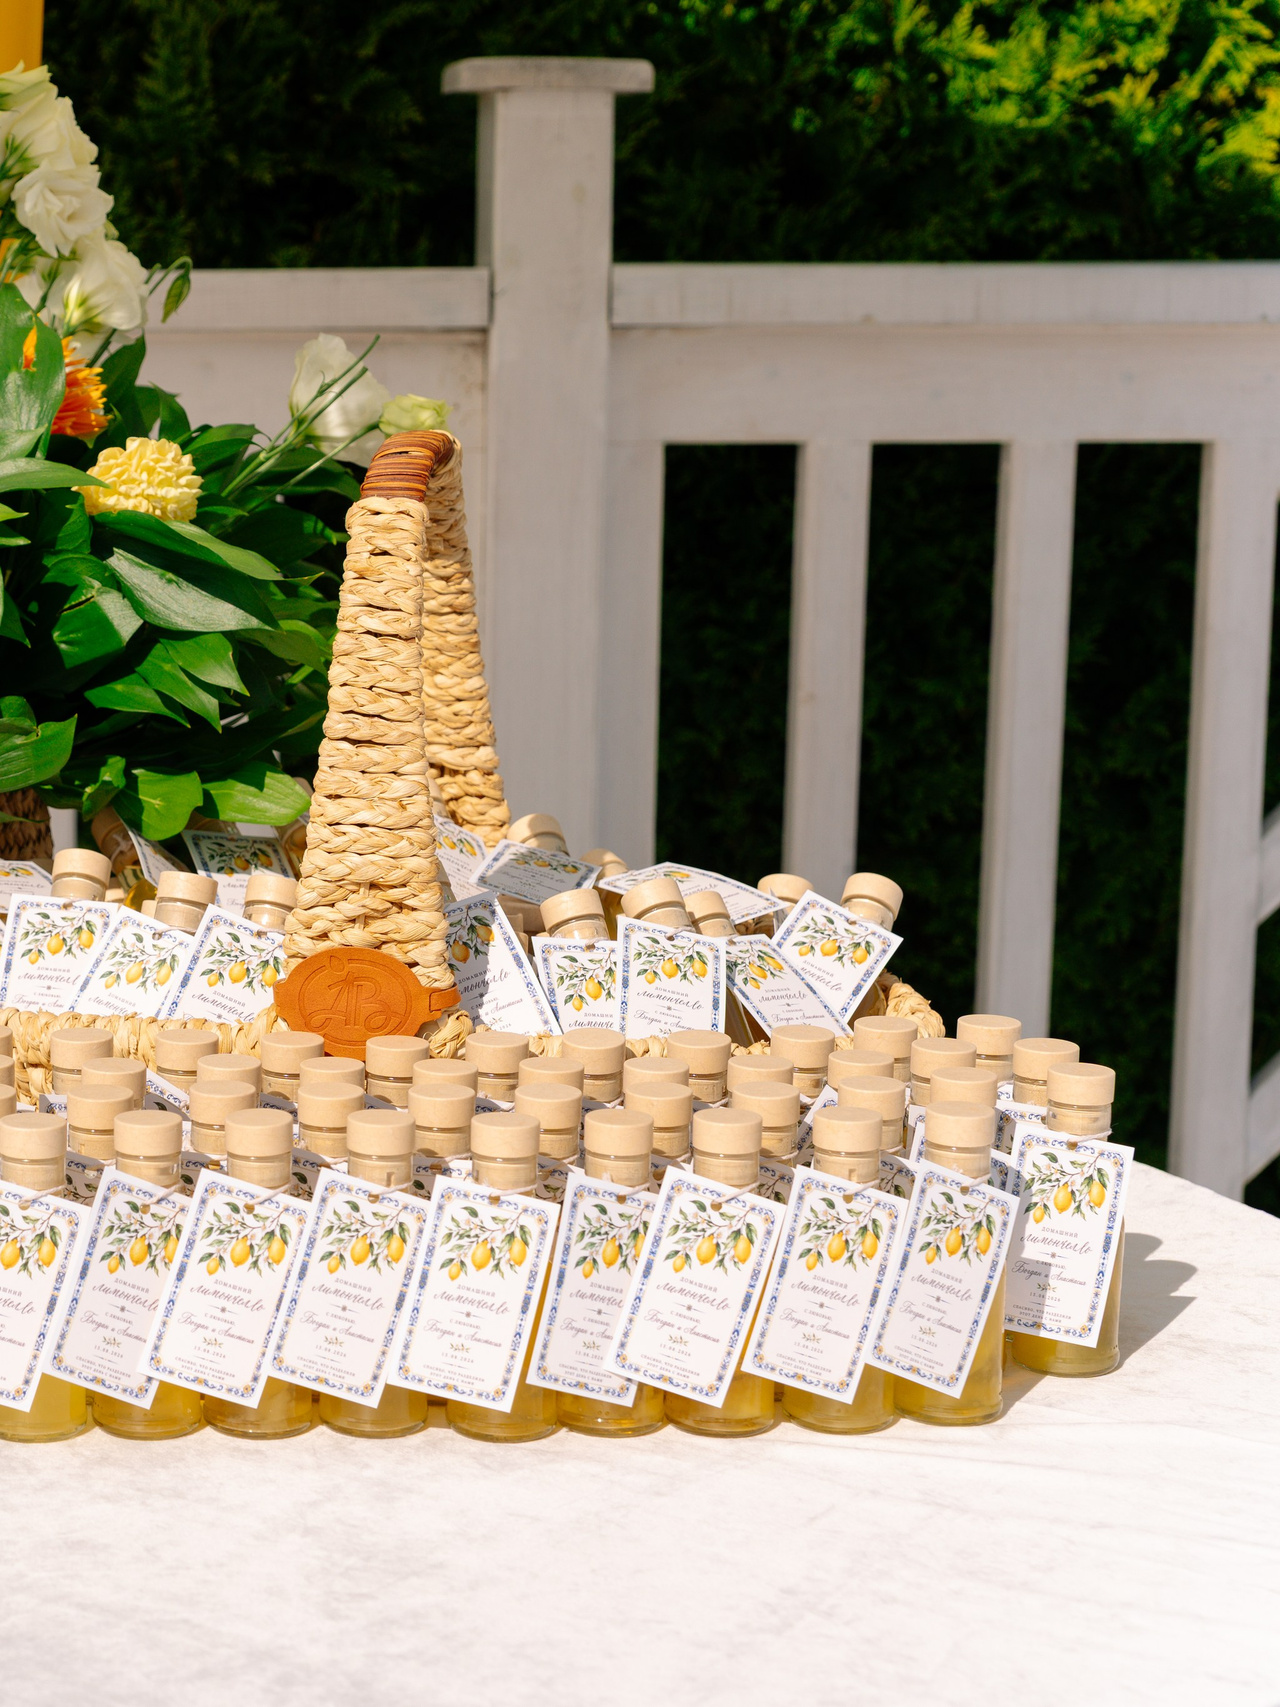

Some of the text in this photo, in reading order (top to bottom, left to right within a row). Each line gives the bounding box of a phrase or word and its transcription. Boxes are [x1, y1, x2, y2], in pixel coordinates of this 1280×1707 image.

[458, 969, 491, 984] ДОМАШНИЙ
[213, 990, 246, 1007] ДОМАШНИЙ
[655, 986, 689, 997] ДОМАШНИЙ
[569, 1018, 614, 1028] лимонче
[634, 1010, 661, 1026] Богдан
[1041, 1226, 1078, 1238] ДОМАШНИЙ
[812, 1274, 847, 1289] ДОМАШНИЙ
[930, 1268, 961, 1284] ДОМАШНИЙ
[1012, 1260, 1042, 1283] Богдан
[1050, 1270, 1086, 1286] Анастасия
[114, 1277, 149, 1294] ДОМАШНИЙ
[213, 1278, 252, 1294] ДОМАШНИЙ
[334, 1277, 372, 1293] ДОМАШНИЙ
[456, 1284, 496, 1298] ДОМАШНИЙ
[589, 1281, 622, 1294] ДОМАШНИЙ
[680, 1276, 718, 1293] ДОМАШНИЙ
[779, 1307, 808, 1333] Богдан
[816, 1322, 850, 1339] Анастасия
[899, 1300, 925, 1326] Богдан
[931, 1316, 962, 1334] Анастасия
[80, 1310, 109, 1337] Богдан
[116, 1326, 147, 1344] Анастаси
[177, 1311, 209, 1337] Богдан
[218, 1327, 255, 1345] Анастасия
[299, 1310, 330, 1336] Богдан
[338, 1325, 374, 1343] Анастасия
[423, 1318, 455, 1343] Богдан
[464, 1331, 502, 1348] Анастасия
[559, 1317, 587, 1341] Богдан
[644, 1309, 675, 1335] Богдан
[683, 1325, 720, 1343] Анастасия
